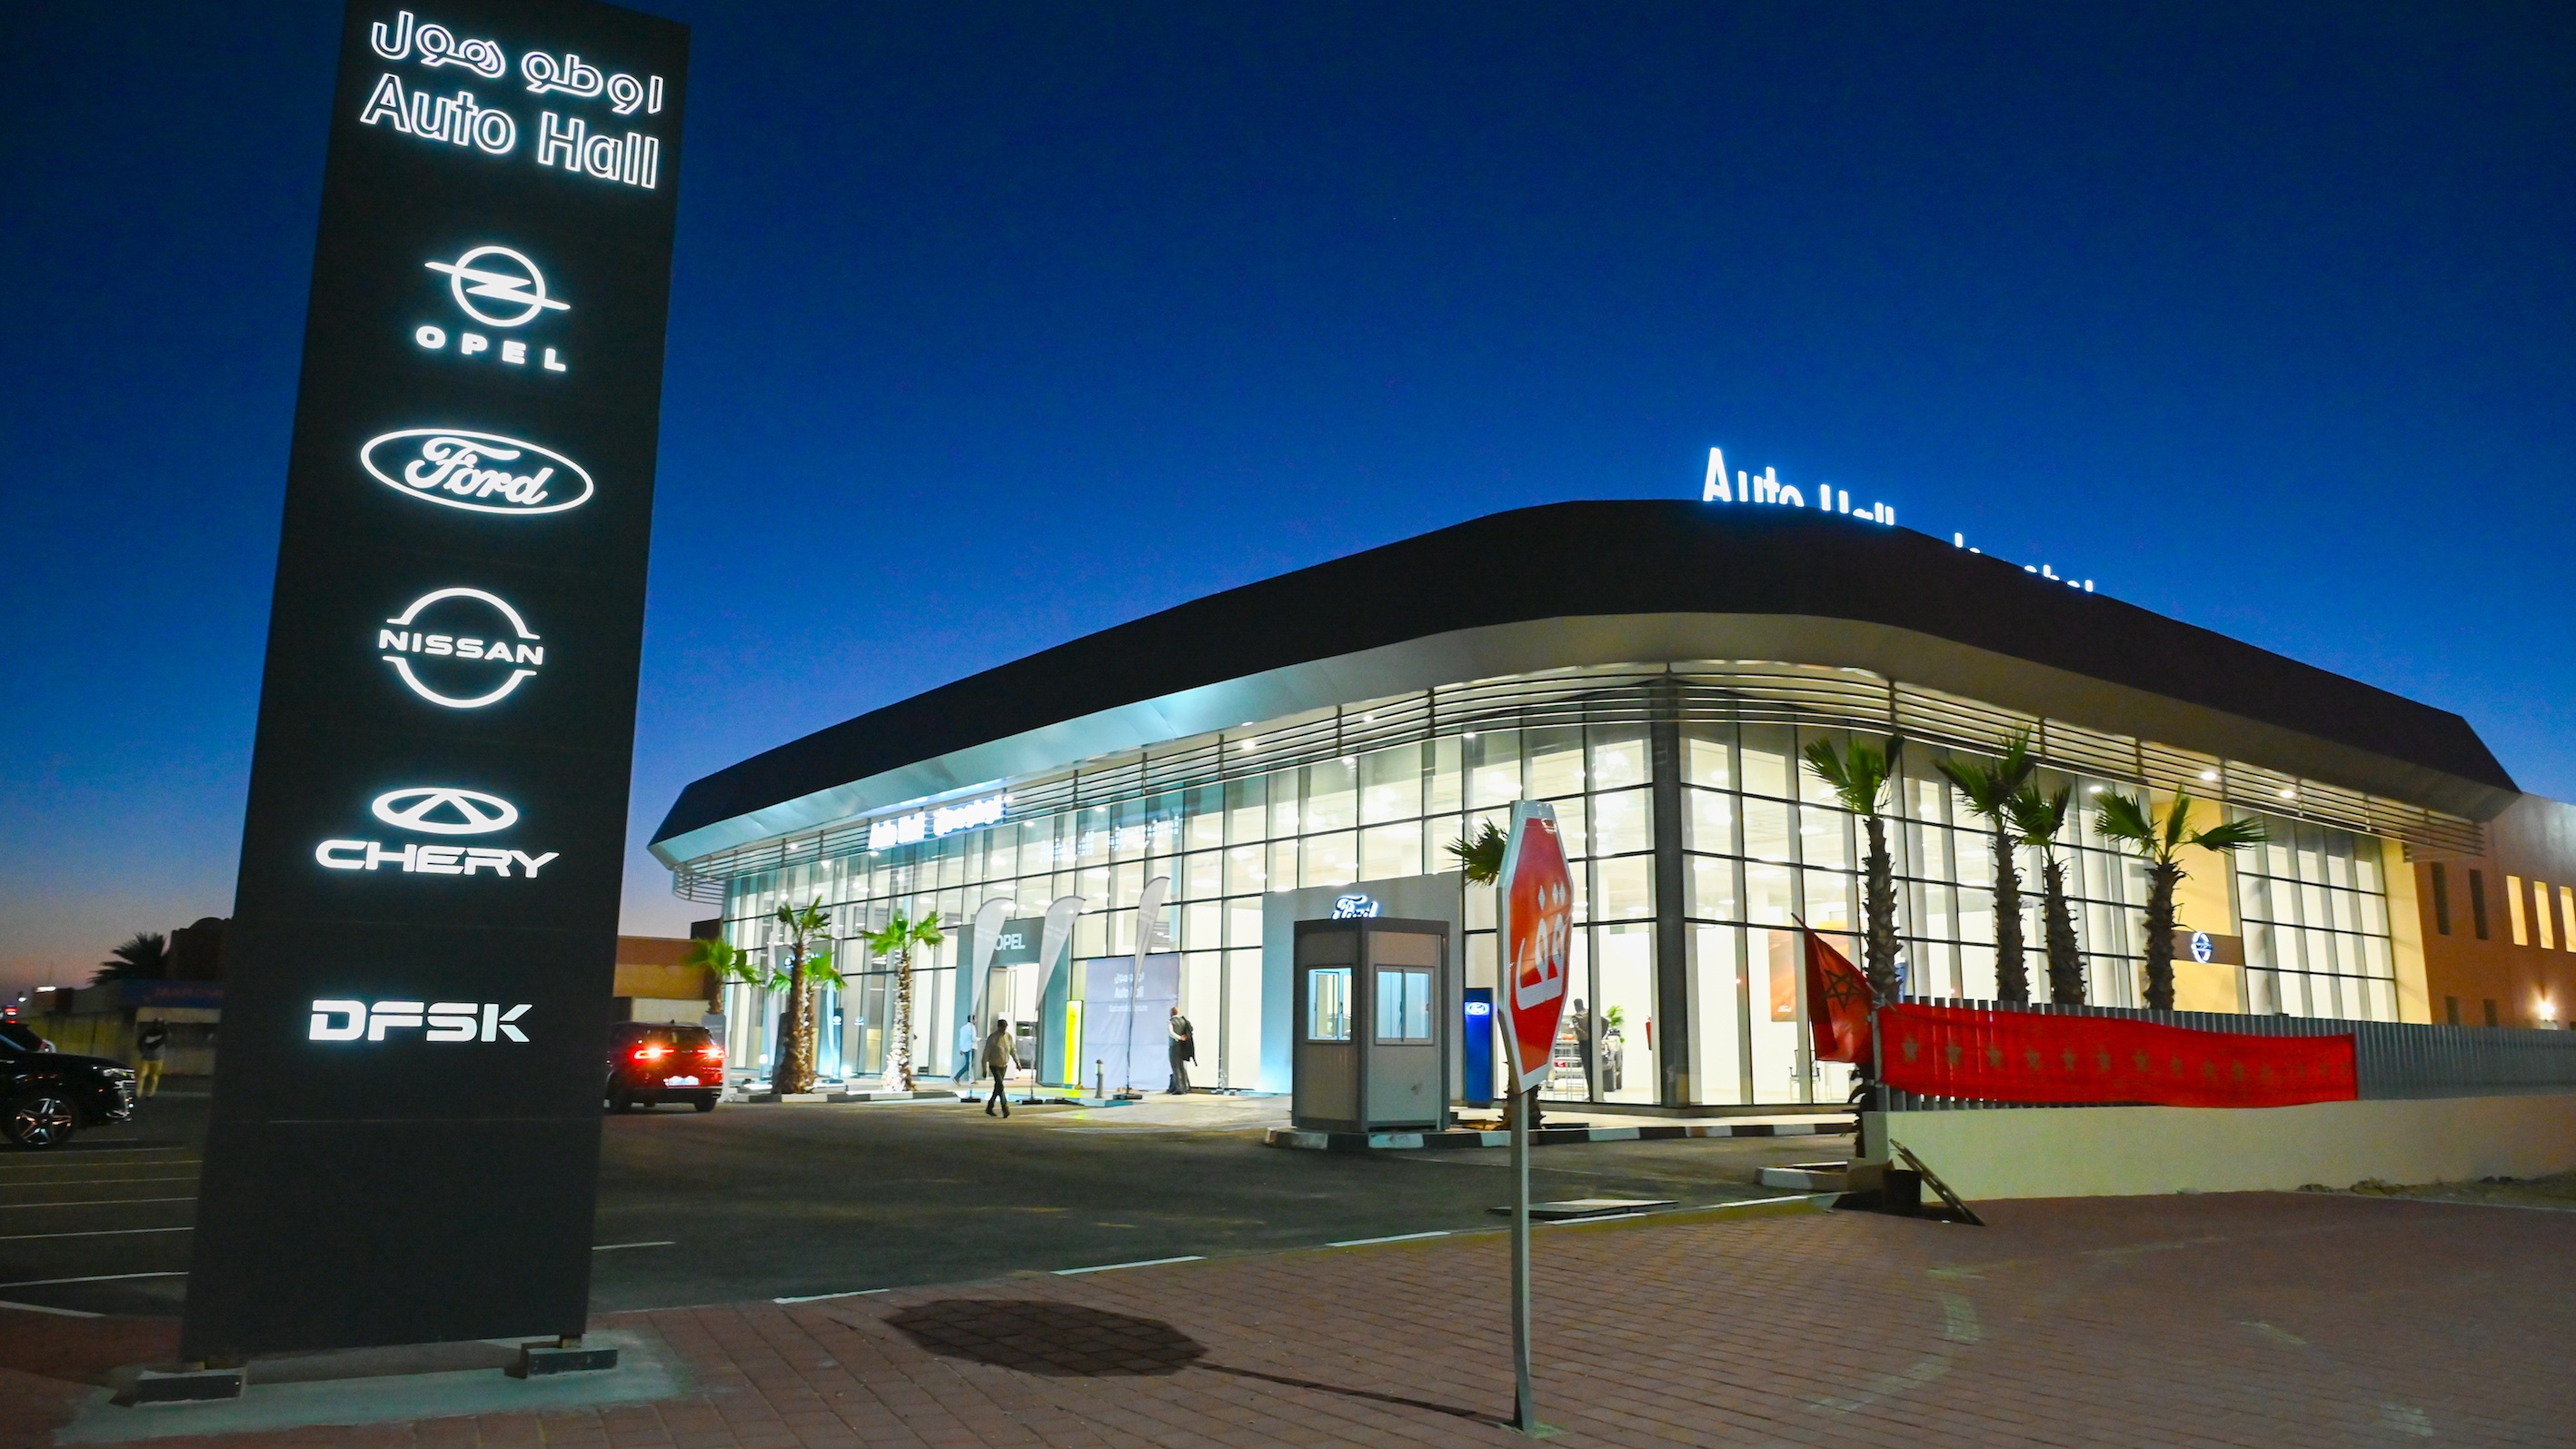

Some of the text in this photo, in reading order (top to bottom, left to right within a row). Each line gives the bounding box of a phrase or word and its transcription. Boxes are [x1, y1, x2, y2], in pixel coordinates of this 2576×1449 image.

[371, 11, 663, 114] اوطو هول
[360, 73, 659, 189] Auto Hall
[415, 326, 566, 372] OPEL
[404, 437, 553, 504] Ford
[378, 629, 544, 665] NISSAN
[315, 839, 560, 878] CHERY
[994, 932, 1026, 951] OPEL
[1516, 881, 1566, 1011] قف
[308, 1000, 532, 1042] DFSK
